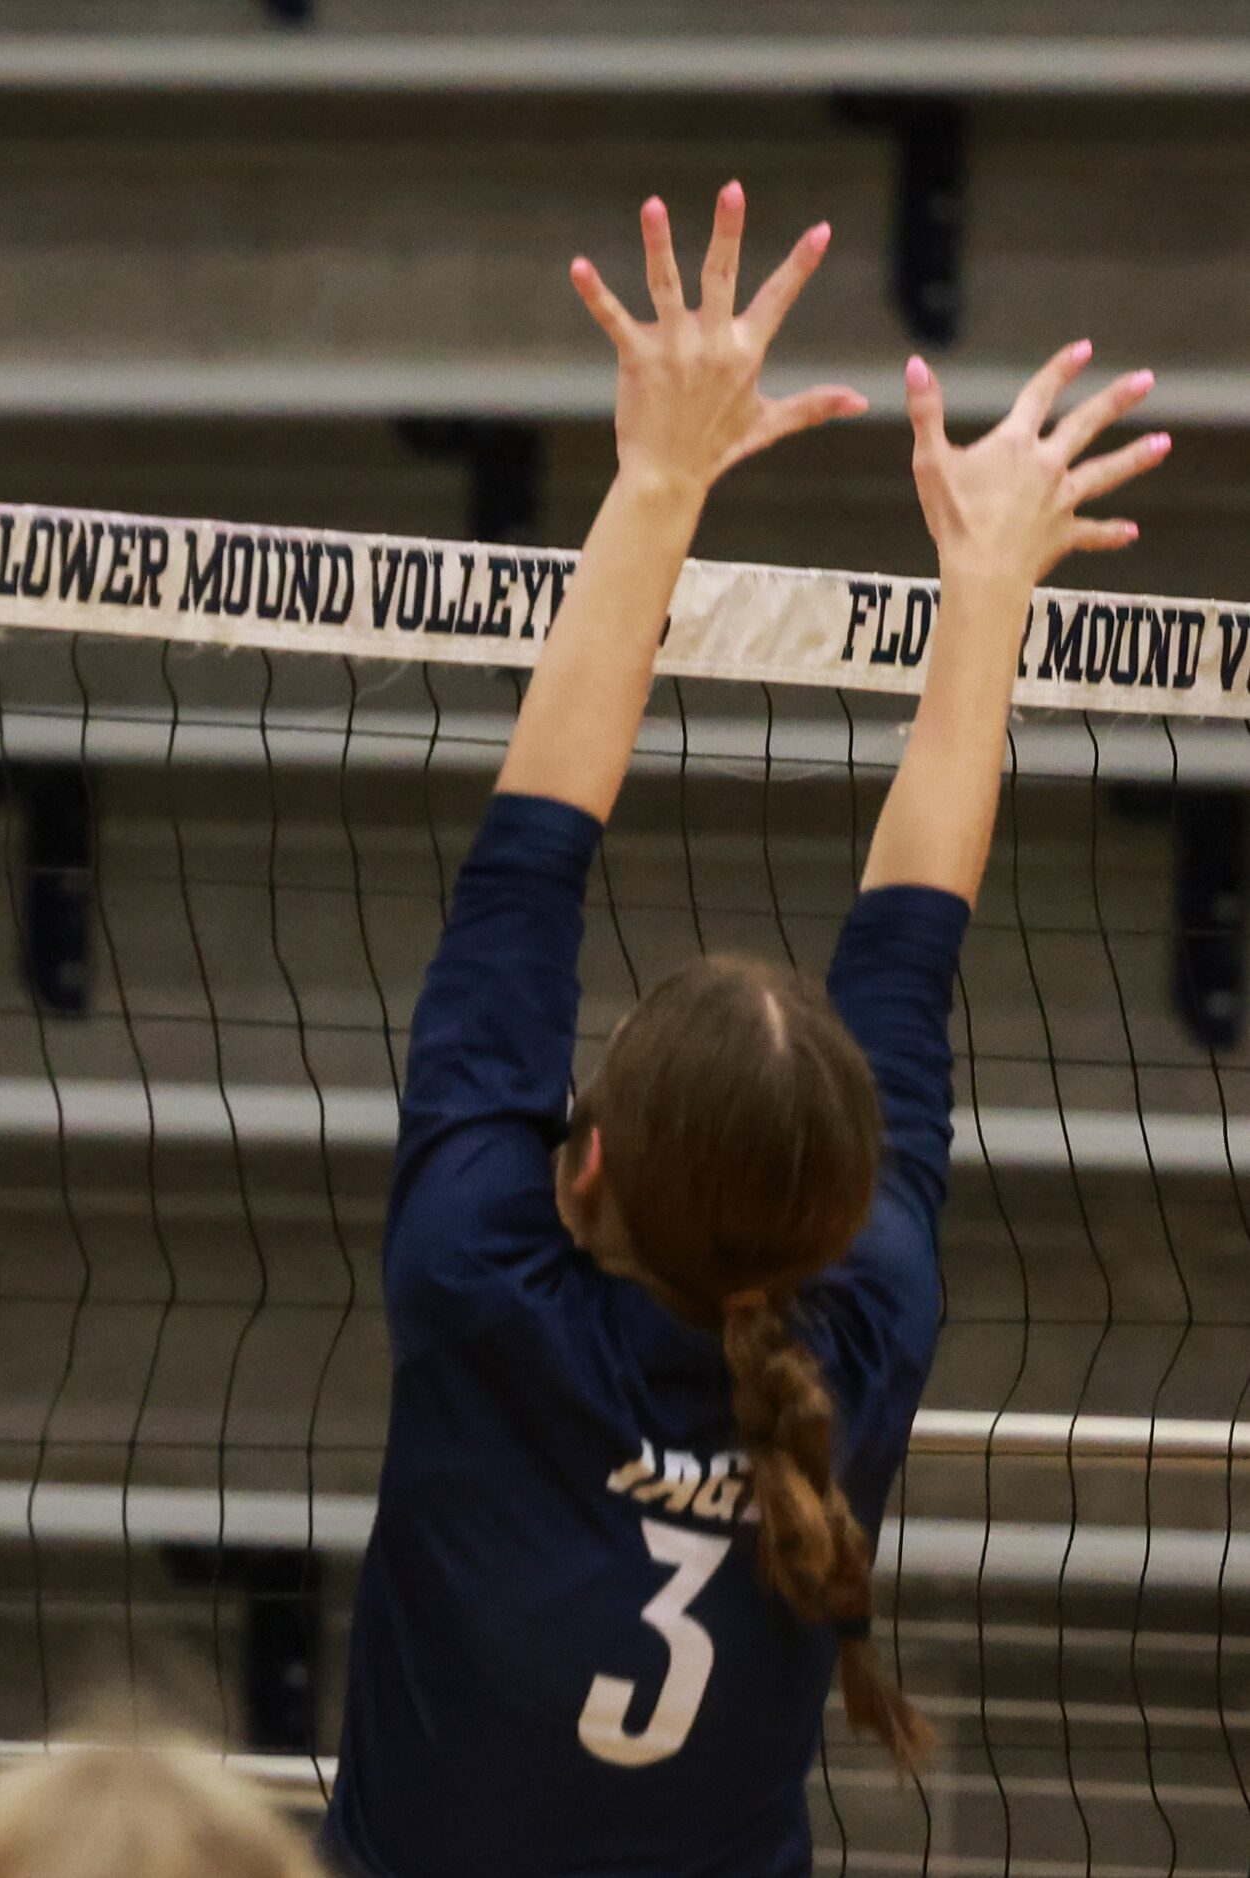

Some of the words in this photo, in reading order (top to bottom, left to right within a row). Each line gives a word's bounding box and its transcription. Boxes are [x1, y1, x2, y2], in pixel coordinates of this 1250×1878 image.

[179, 529, 354, 625] MOUND
[1037, 600, 1205, 690] MOUND
[578, 1517, 732, 1766] 3
